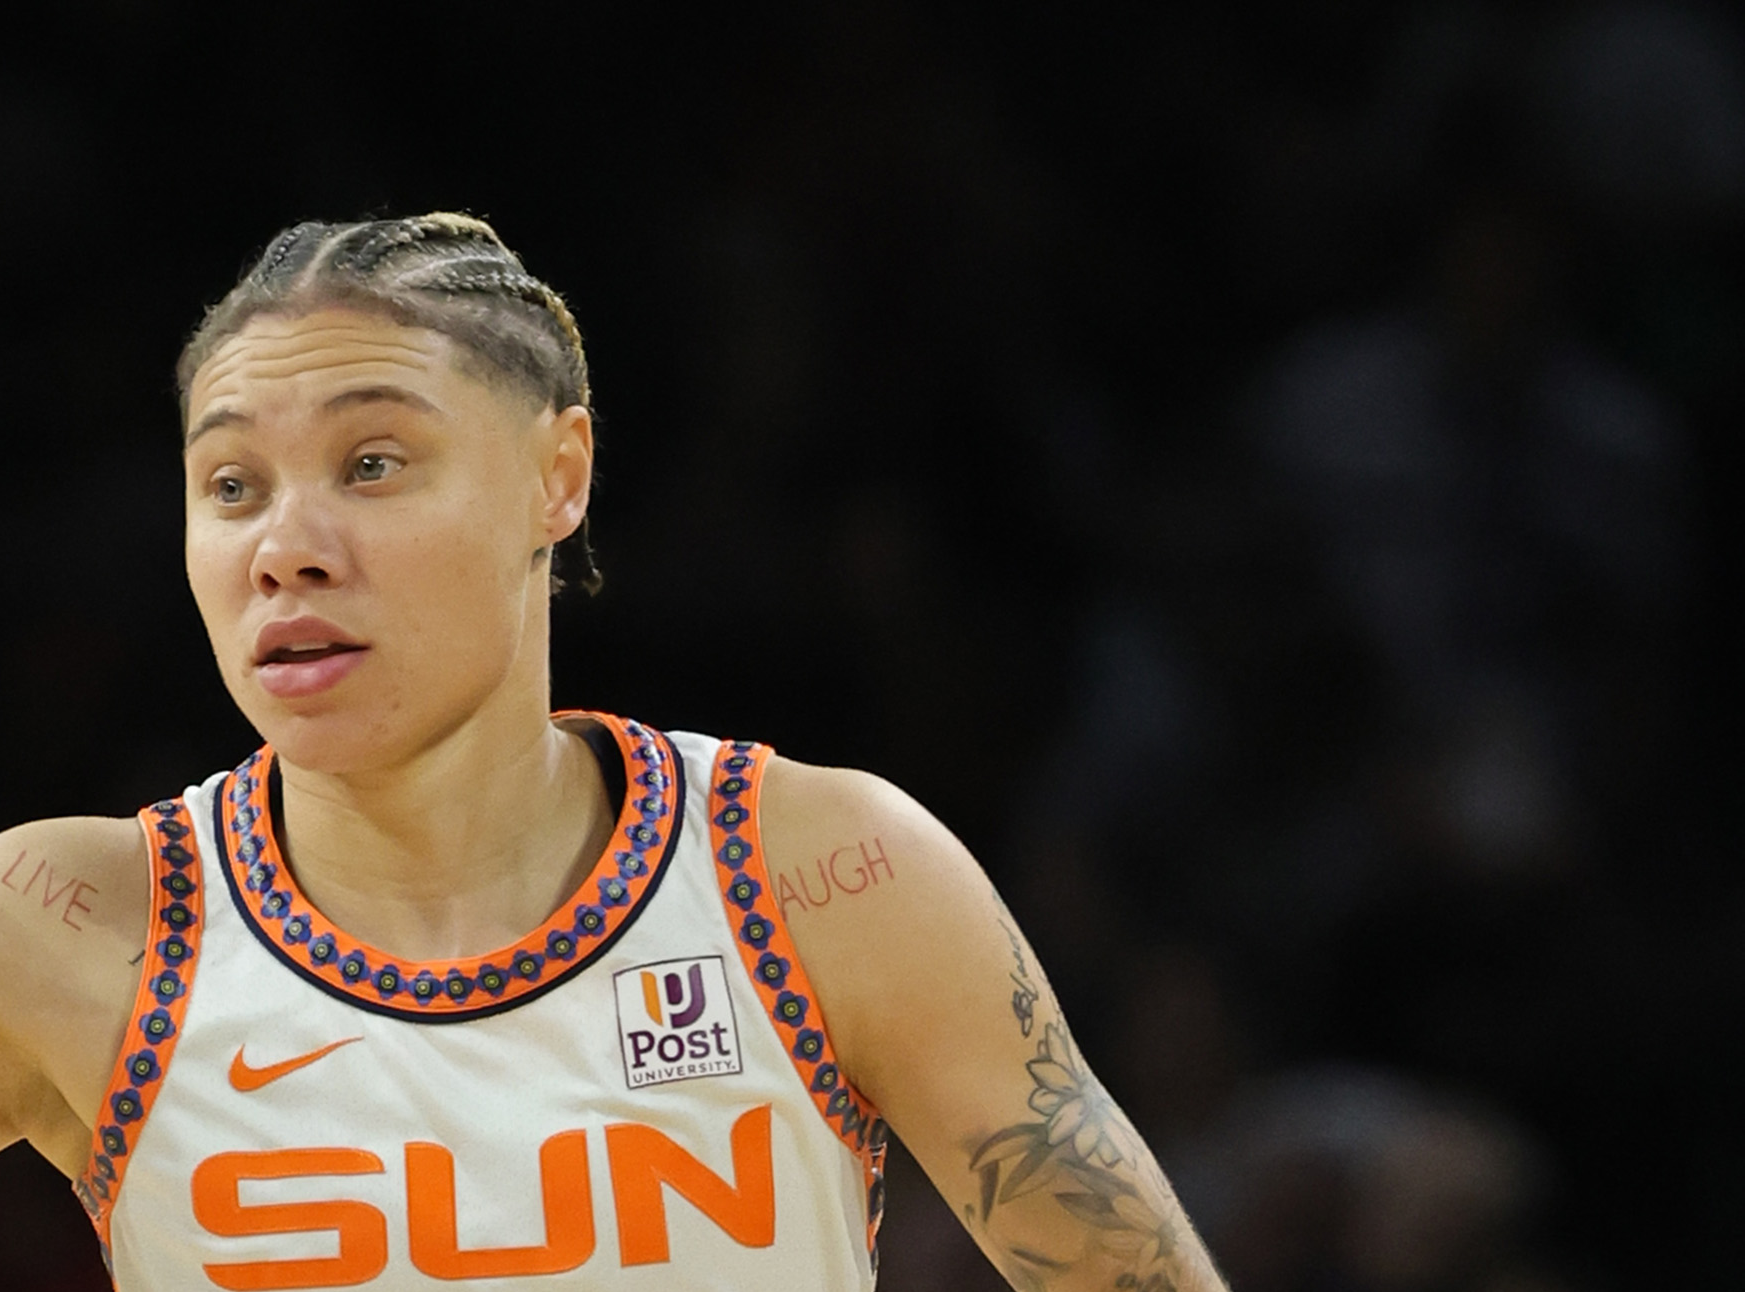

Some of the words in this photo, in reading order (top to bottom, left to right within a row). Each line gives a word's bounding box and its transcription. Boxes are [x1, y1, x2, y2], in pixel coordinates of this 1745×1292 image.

[1, 850, 98, 932] LIVE
[777, 837, 895, 922] AUGH
[627, 1022, 731, 1069] Post
[190, 1102, 775, 1292] SUN
